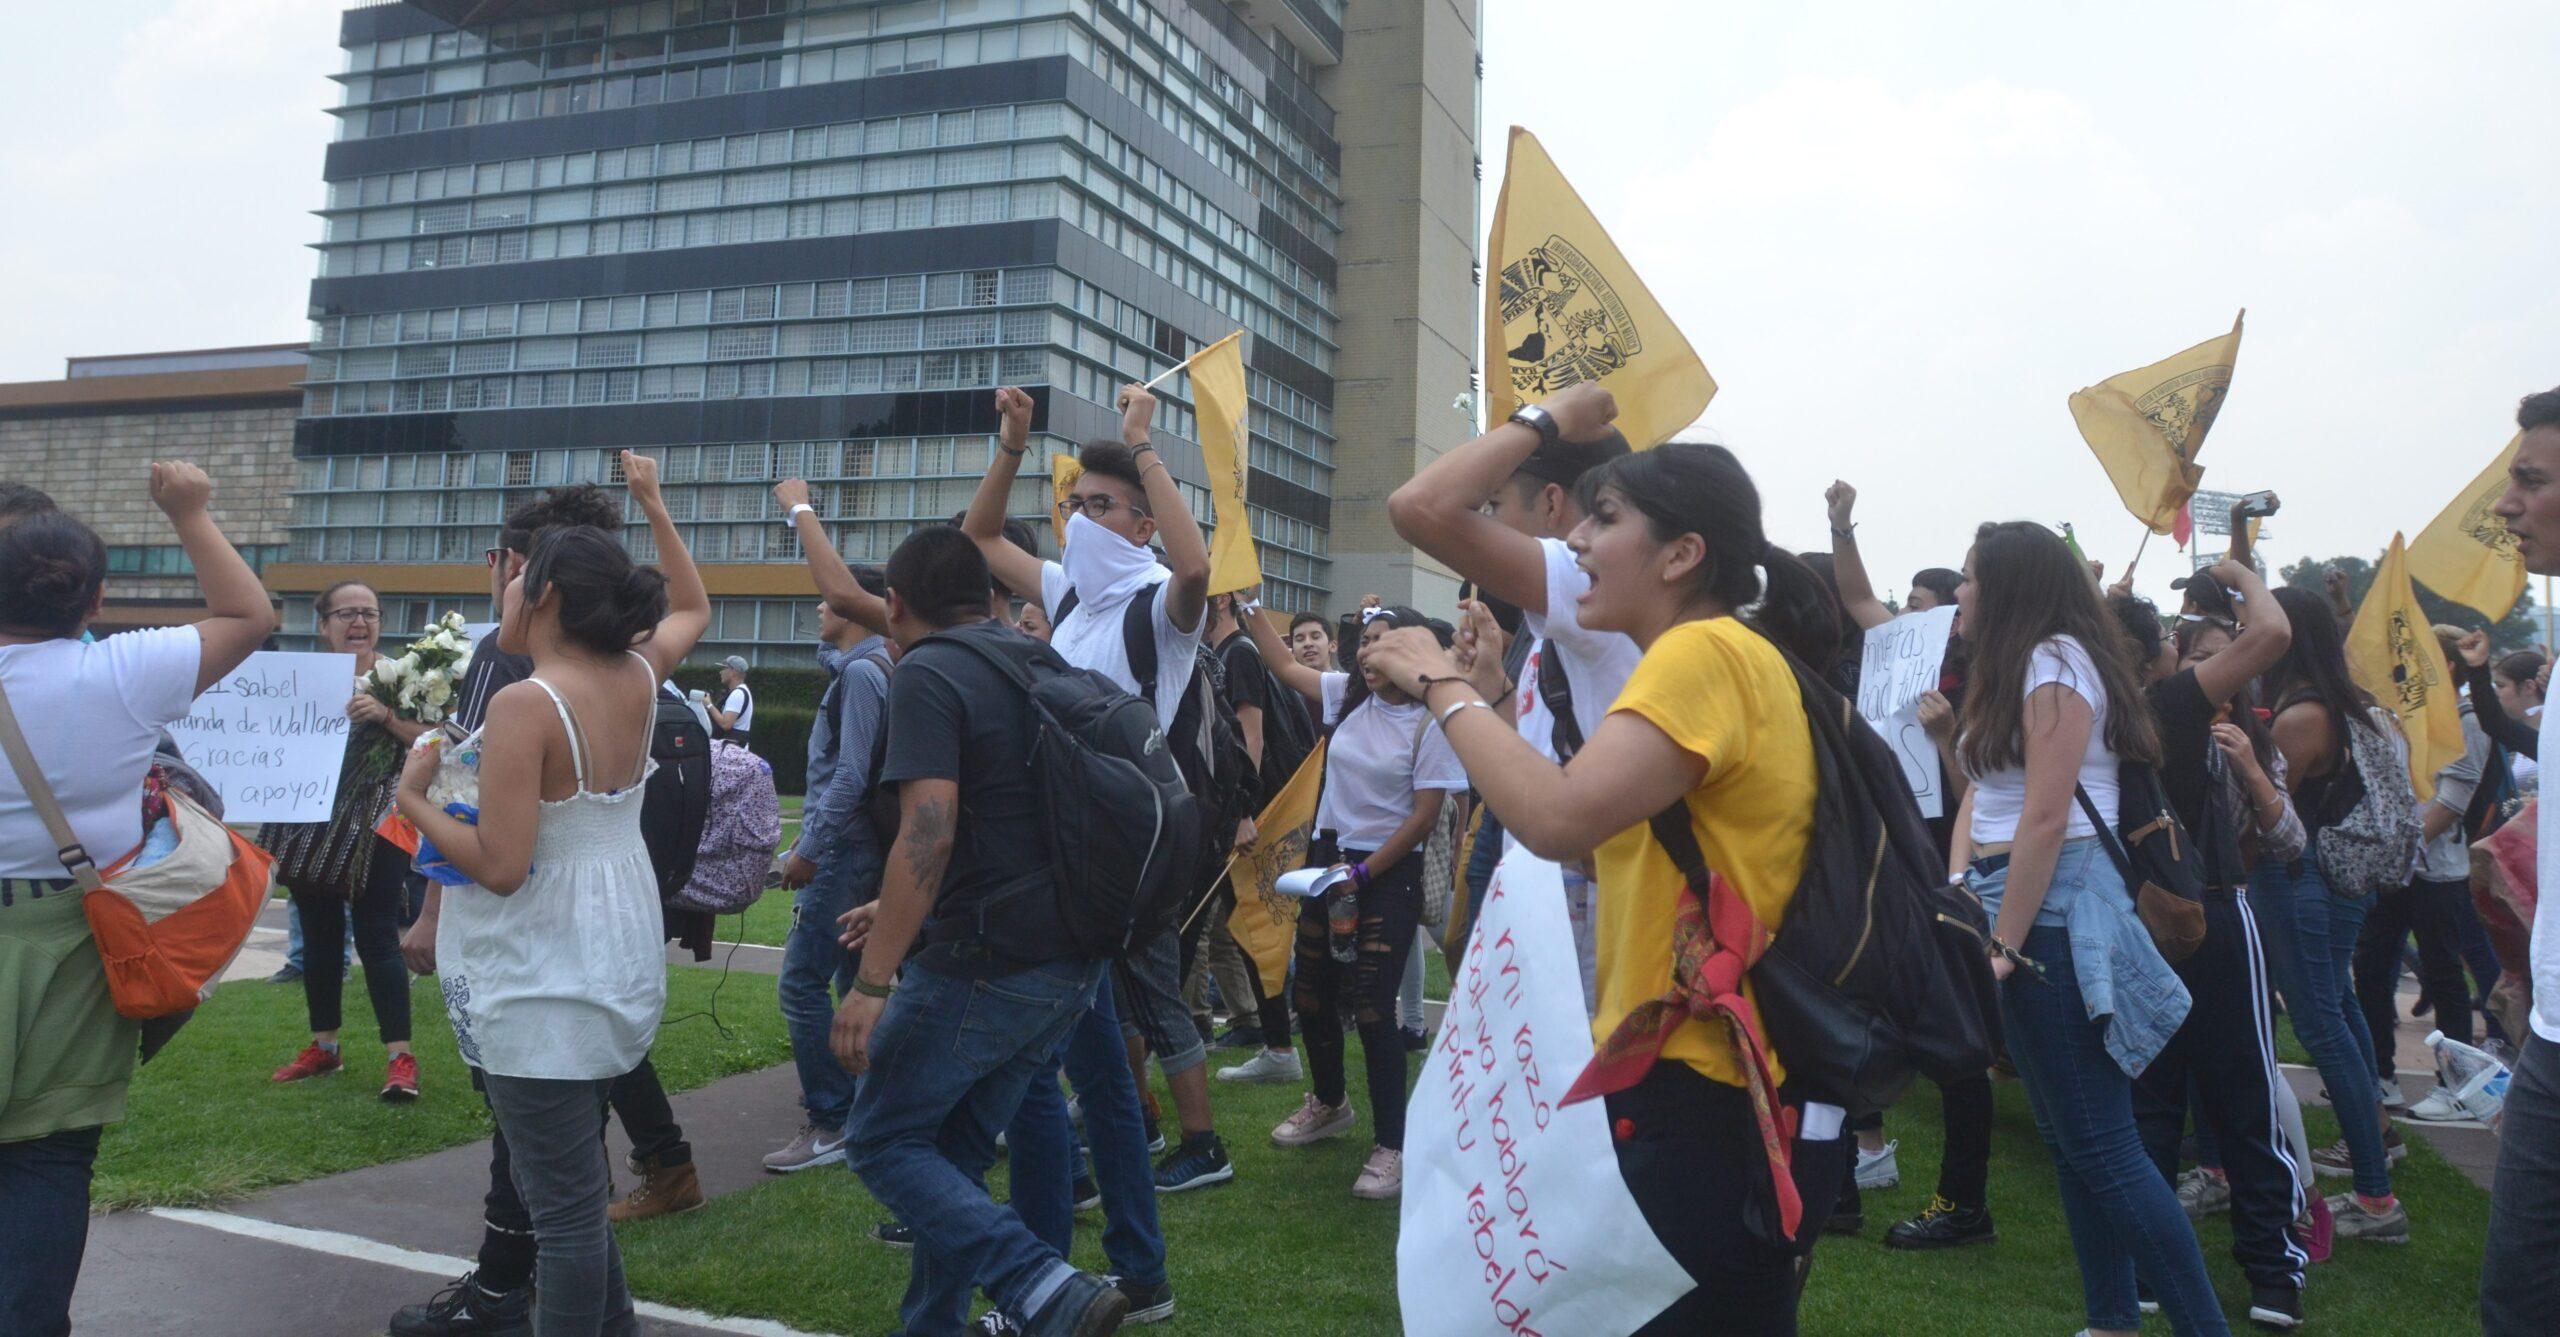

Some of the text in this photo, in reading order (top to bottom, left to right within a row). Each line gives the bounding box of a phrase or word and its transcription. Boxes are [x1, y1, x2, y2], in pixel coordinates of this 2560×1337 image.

[1503, 294, 1540, 324] PIRITV
[1543, 297, 1561, 318] POR
[1561, 323, 1580, 341] MI
[1538, 341, 1576, 367] RAZA
[205, 669, 298, 697] Isabel
[236, 706, 261, 734] de
[183, 741, 285, 770] Gracias
[240, 775, 329, 811] apoyo!
[1495, 927, 1523, 1010] mi
[1438, 983, 1476, 1152] spíritu
[1488, 1081, 1568, 1286] hablará
